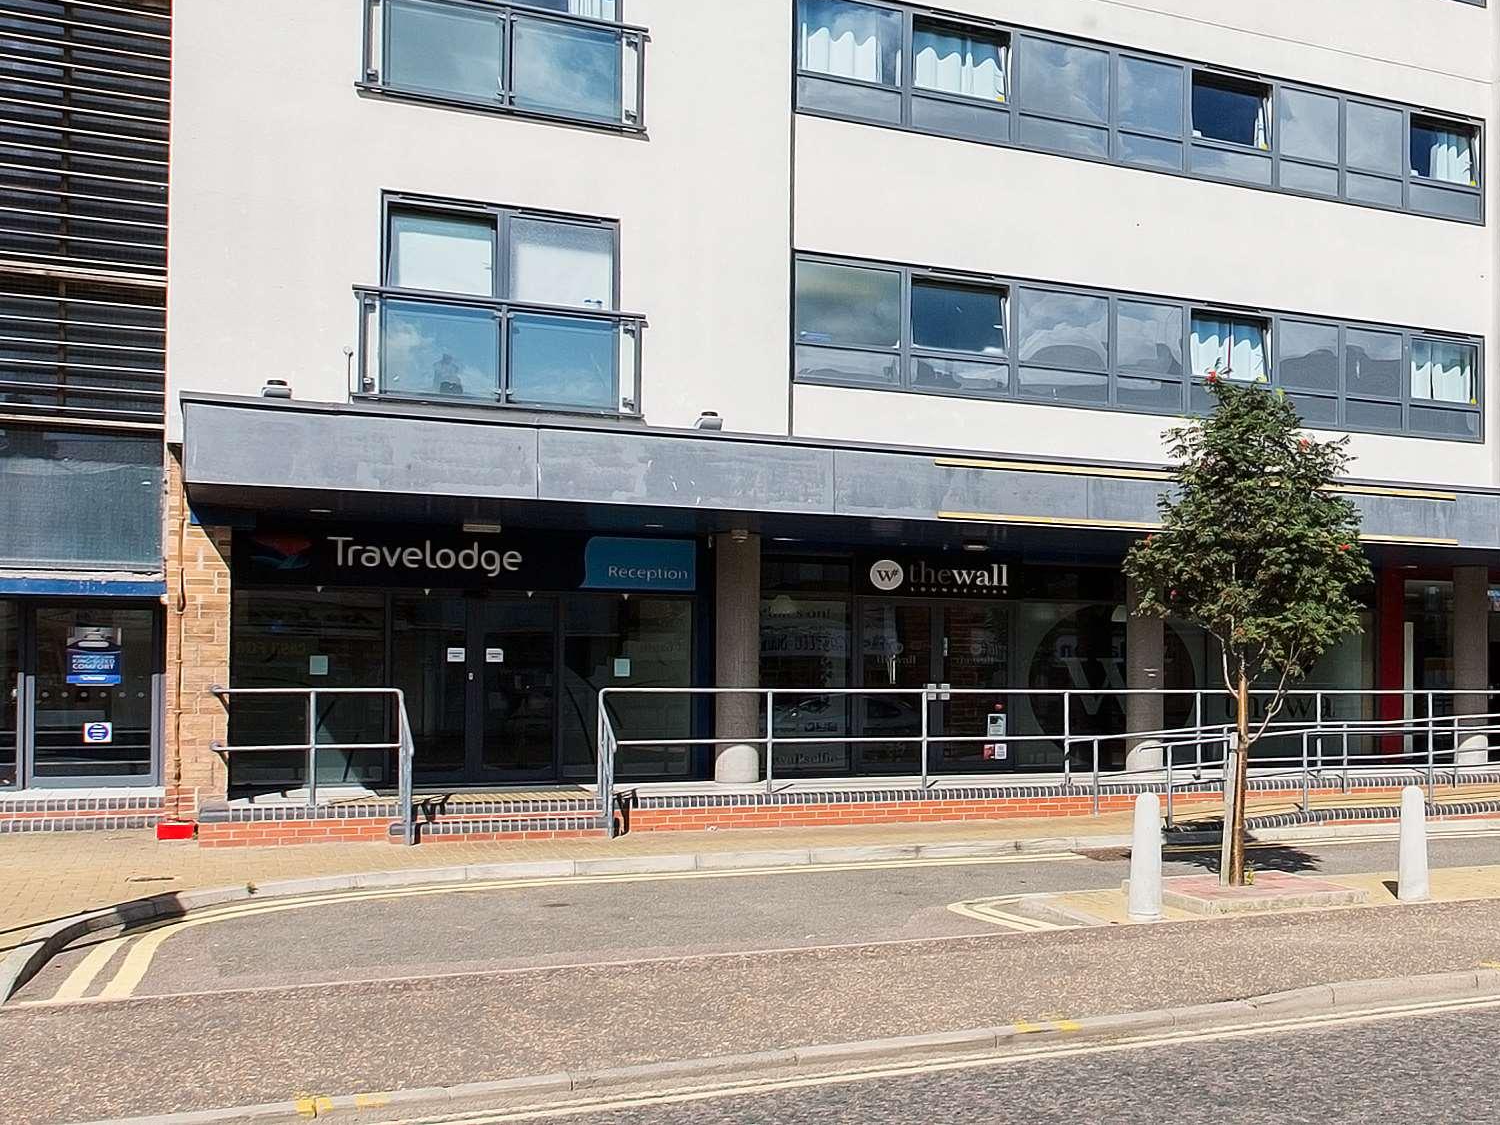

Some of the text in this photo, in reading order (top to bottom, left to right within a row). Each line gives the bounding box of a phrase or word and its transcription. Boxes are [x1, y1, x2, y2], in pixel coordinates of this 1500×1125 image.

[326, 536, 523, 577] Travelodge
[607, 564, 688, 581] Reception
[909, 562, 1009, 586] thewall
